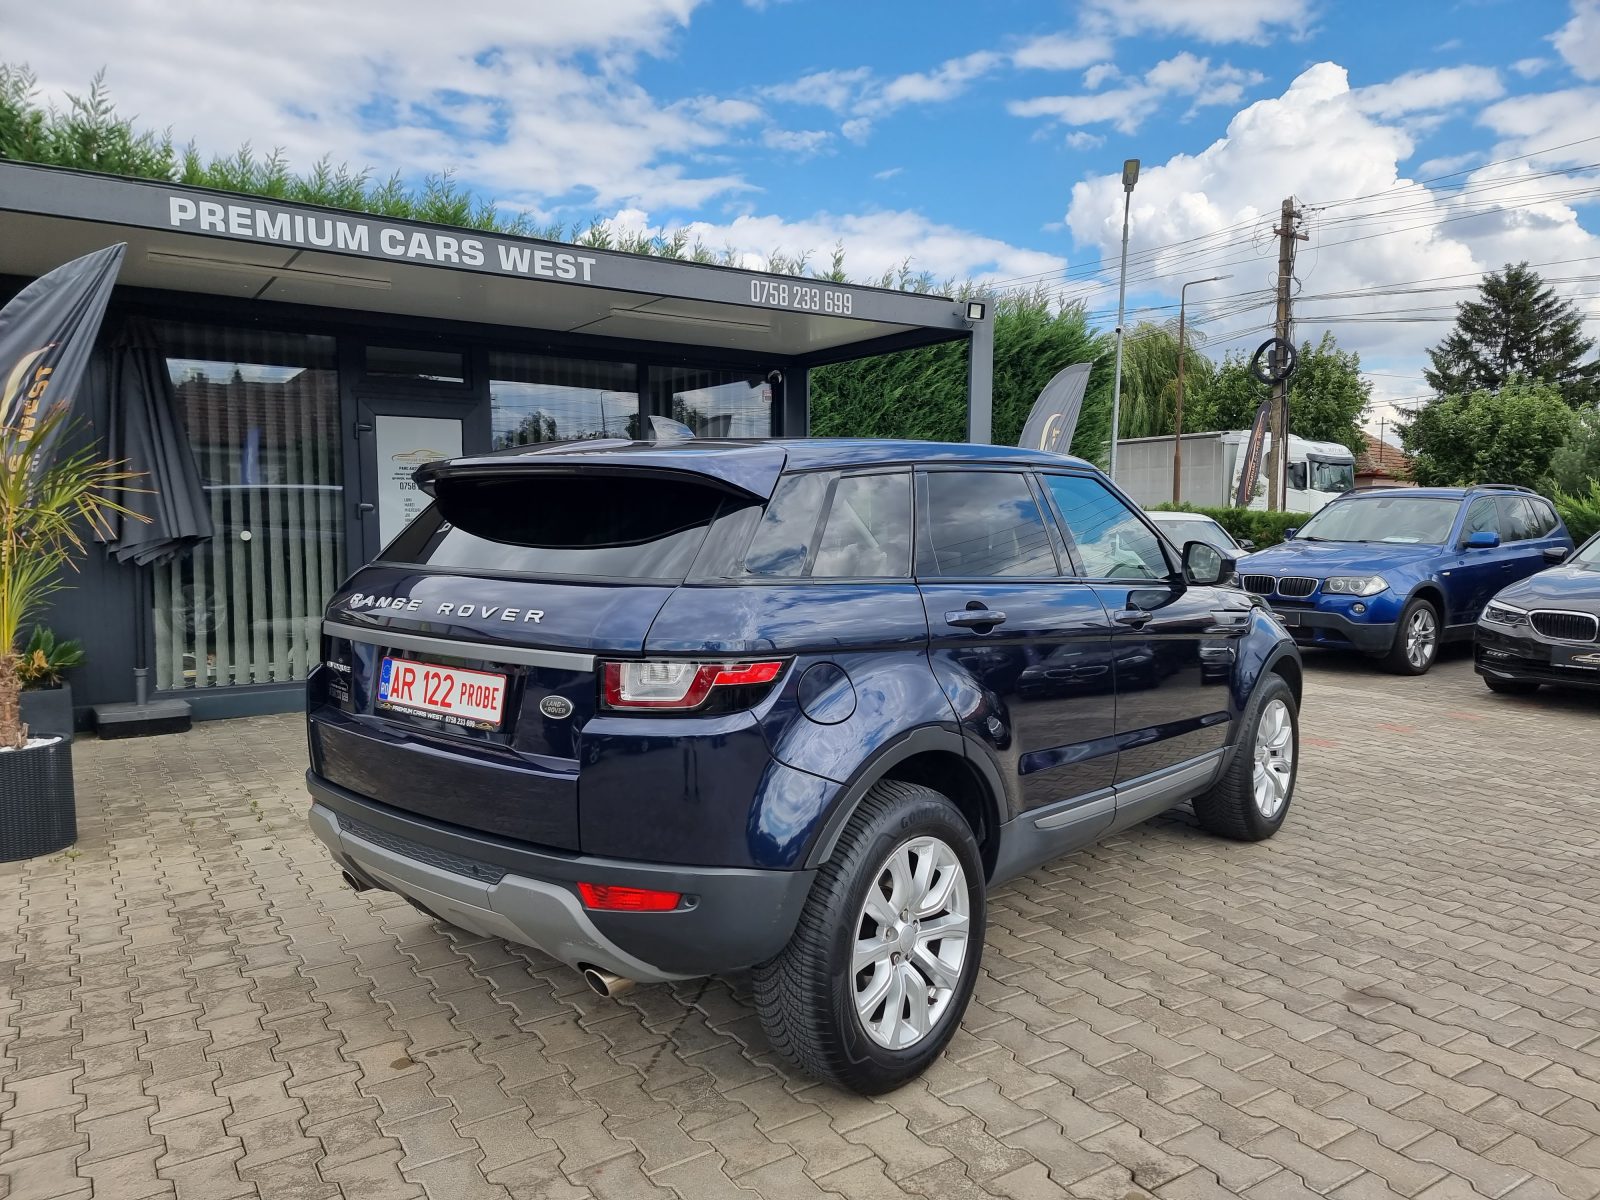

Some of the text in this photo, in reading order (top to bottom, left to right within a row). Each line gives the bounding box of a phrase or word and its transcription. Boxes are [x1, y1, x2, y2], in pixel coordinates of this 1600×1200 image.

[169, 196, 596, 282] PREMIUM CARS WEST
[751, 280, 852, 315] 0758 233 699
[18, 364, 53, 443] WEST
[400, 482, 416, 490] 0758
[350, 593, 545, 624] RANGE ROVER
[381, 682, 389, 695] RO
[390, 666, 416, 701] AR
[423, 671, 455, 708] 122
[459, 682, 499, 710] PROBE
[391, 705, 413, 715] PREMIUM
[413, 709, 427, 718] CARS
[427, 712, 444, 721] WEST
[547, 706, 565, 714] ROVER
